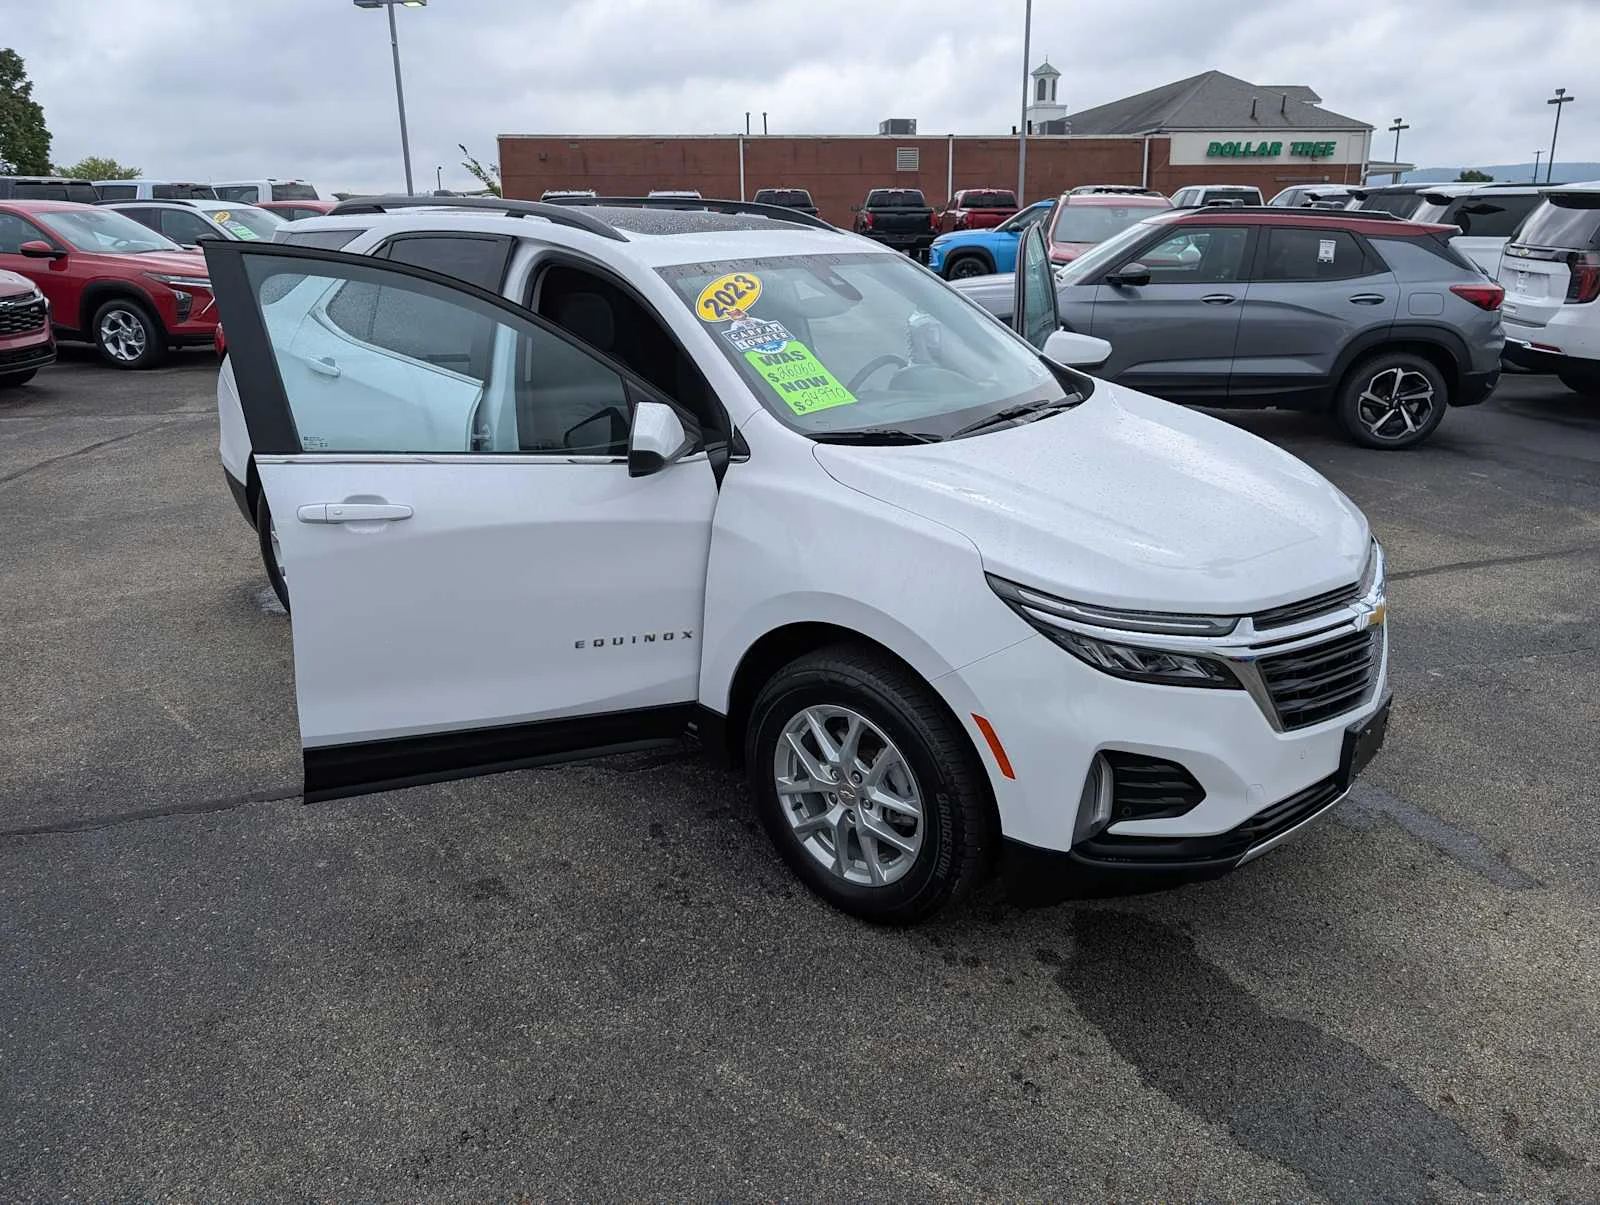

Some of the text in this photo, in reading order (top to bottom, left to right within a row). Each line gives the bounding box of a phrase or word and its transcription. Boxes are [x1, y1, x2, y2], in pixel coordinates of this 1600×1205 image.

[1206, 141, 1337, 158] DOLLAR TREE
[704, 275, 756, 318] 2023
[727, 322, 785, 341] CARFAX
[758, 350, 807, 366] WAS
[780, 375, 830, 393] NOW
[575, 630, 693, 649] EQUINOX
